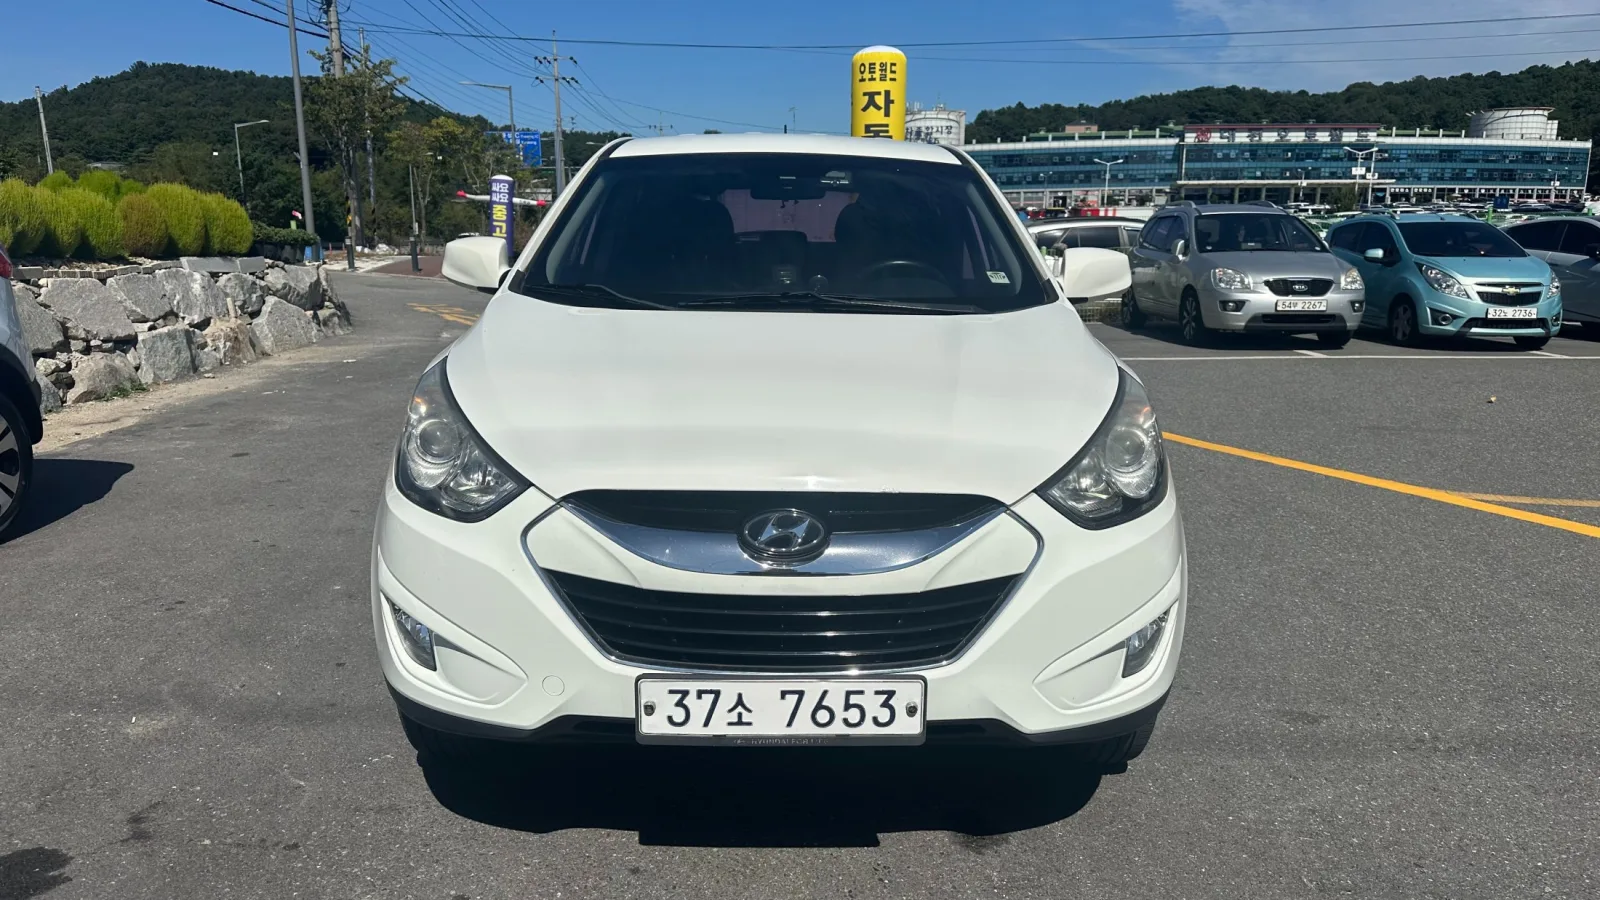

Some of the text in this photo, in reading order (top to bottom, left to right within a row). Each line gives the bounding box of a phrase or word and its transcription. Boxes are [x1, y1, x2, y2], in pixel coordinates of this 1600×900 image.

[858, 61, 897, 82] 오토월드
[491, 182, 509, 192] 싸요
[491, 192, 509, 203] 싸요
[492, 204, 508, 238] 중고
[1301, 301, 1323, 310] 2267
[1511, 309, 1533, 318] 2736
[667, 689, 897, 729] 37소 7653
